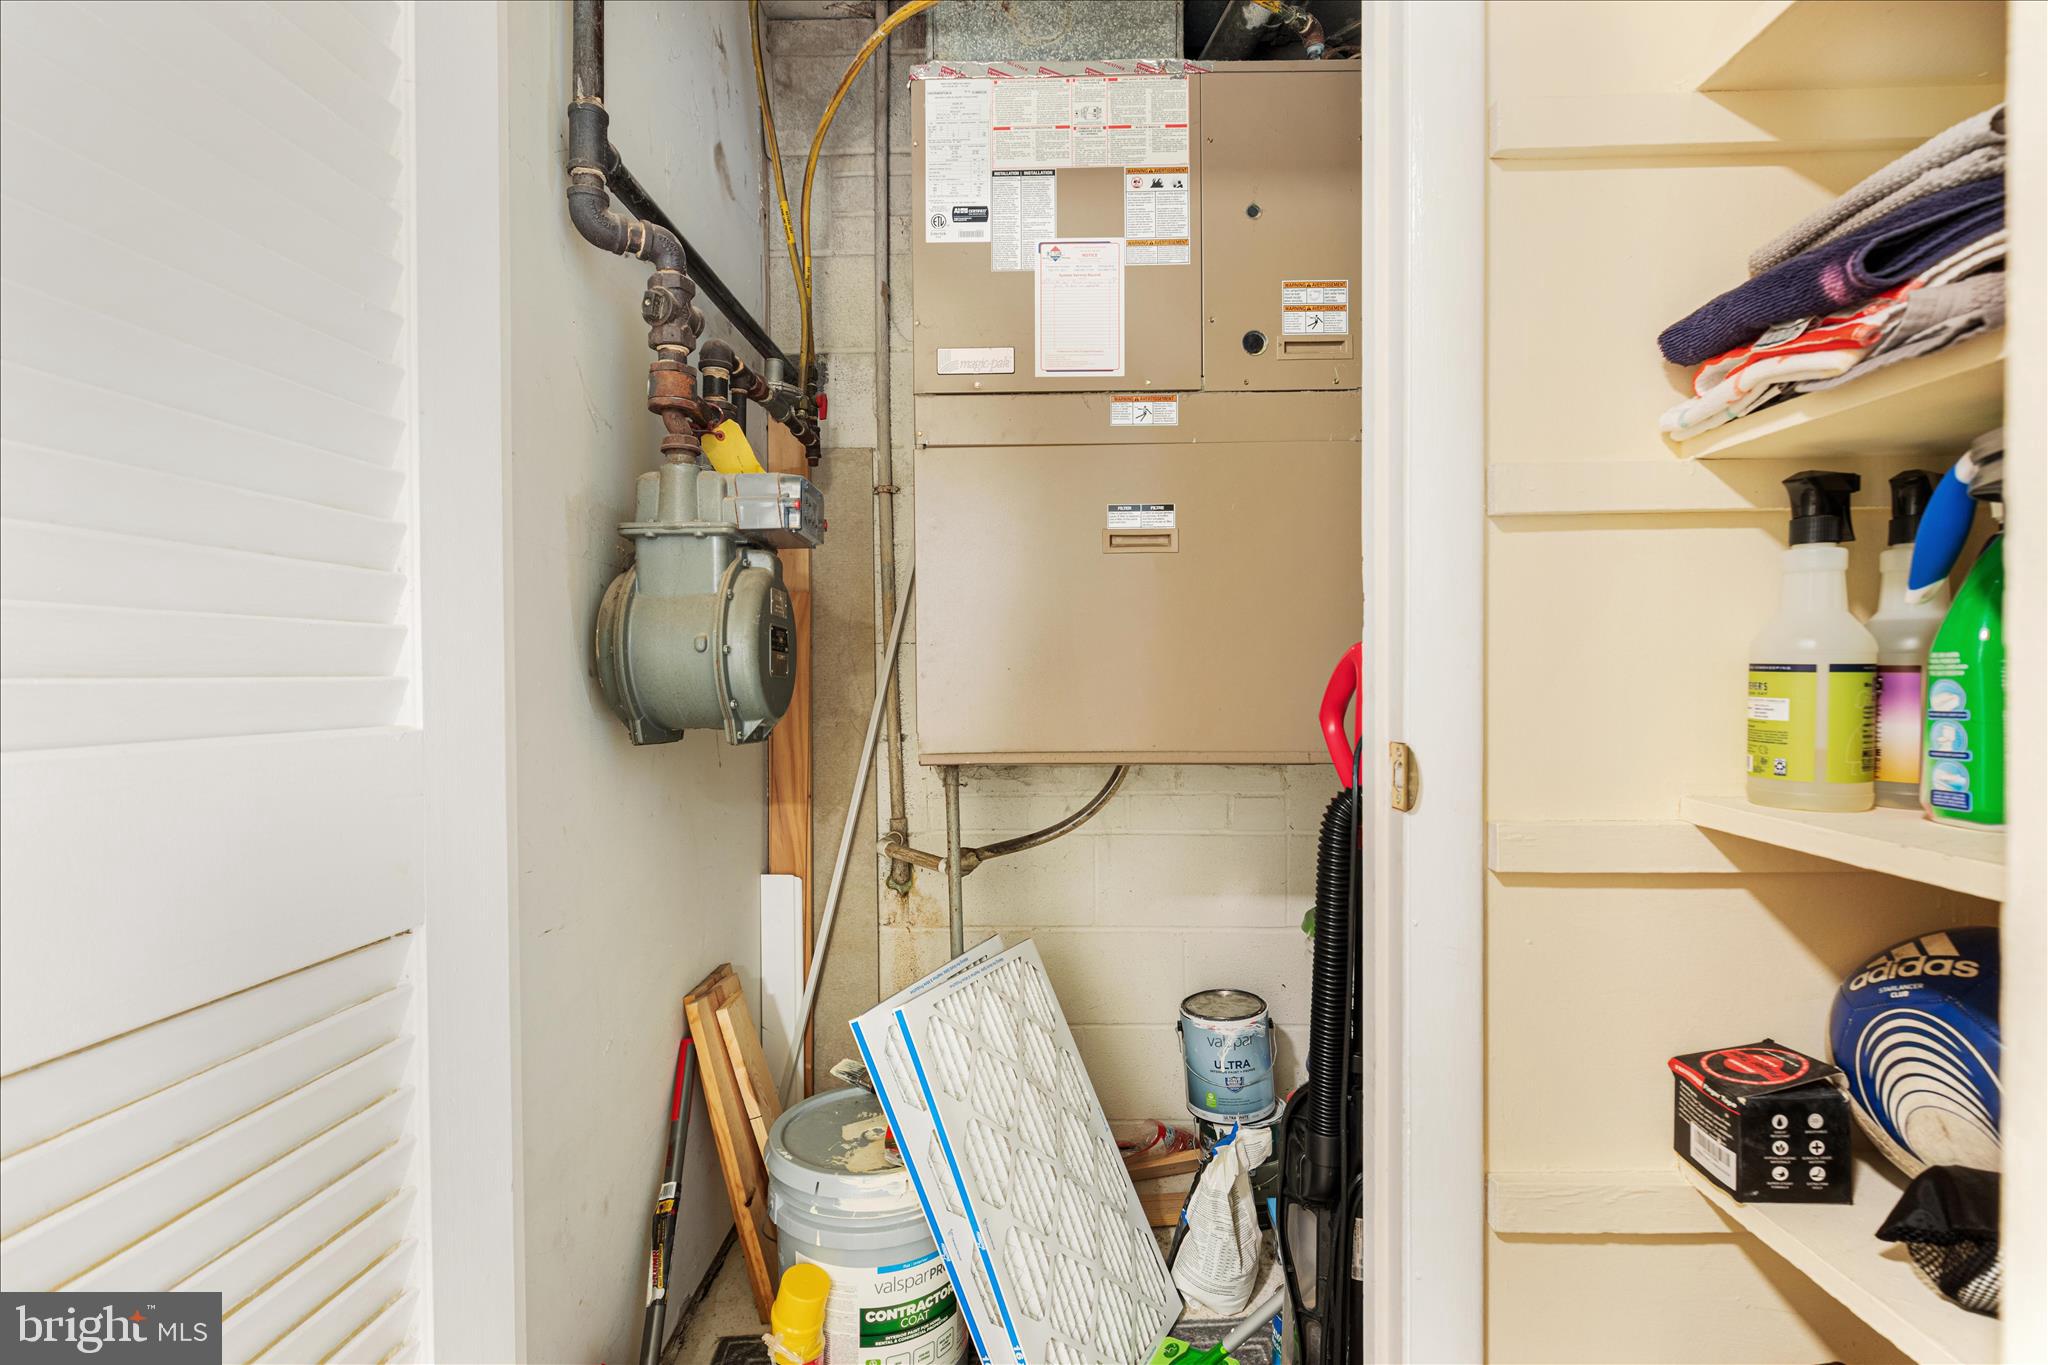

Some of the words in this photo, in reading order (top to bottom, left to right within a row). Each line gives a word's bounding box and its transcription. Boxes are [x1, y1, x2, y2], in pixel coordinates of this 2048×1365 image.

[1849, 955, 1980, 991] adidas
[1206, 1034, 1255, 1051] valpar
[865, 1284, 954, 1323] CONTRACTOR
[900, 1309, 930, 1328] COAT
